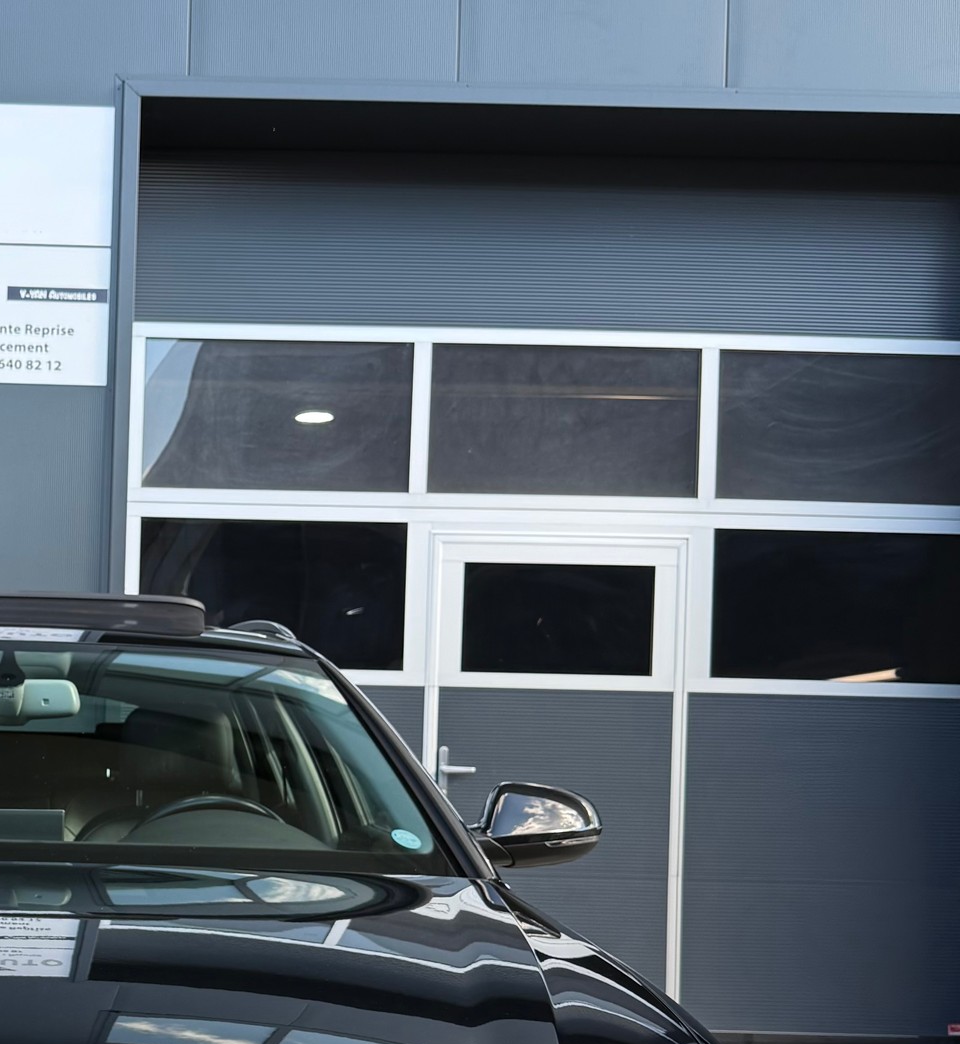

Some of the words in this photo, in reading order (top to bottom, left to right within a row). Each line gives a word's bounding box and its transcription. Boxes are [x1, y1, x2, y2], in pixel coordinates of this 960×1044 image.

[25, 324, 75, 338] Reprise
[25, 359, 42, 370] 82
[47, 360, 62, 371] 12
